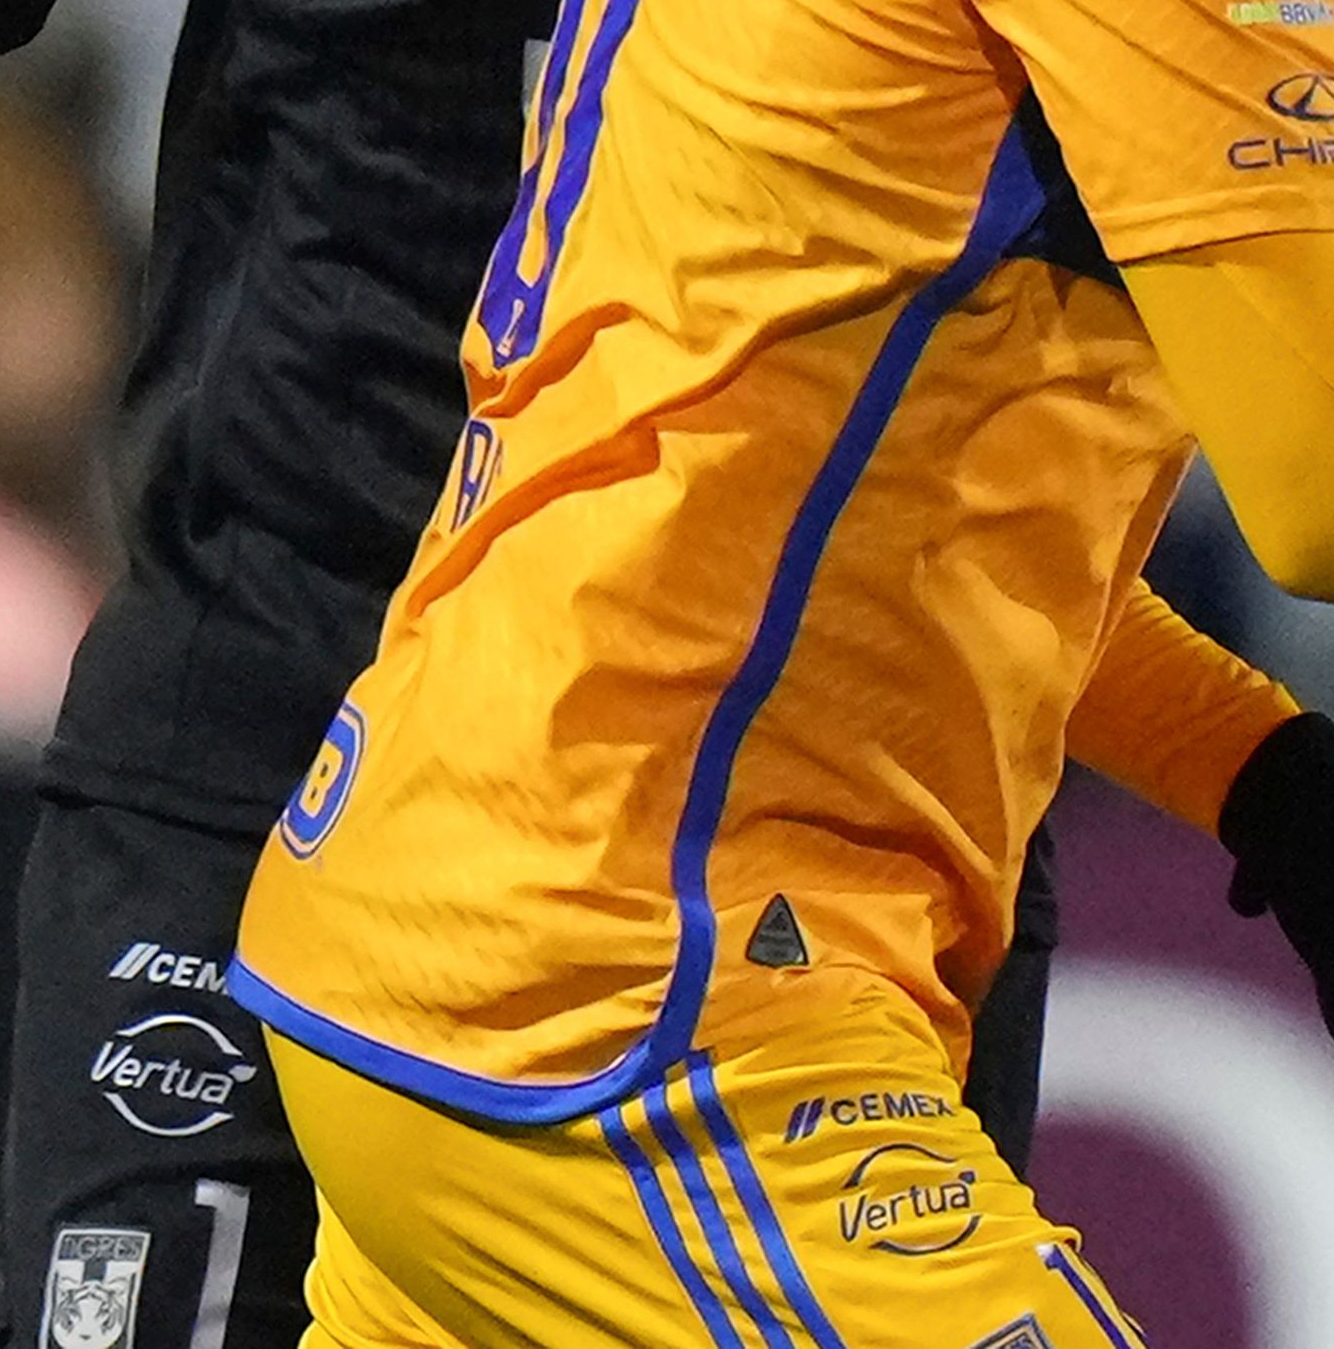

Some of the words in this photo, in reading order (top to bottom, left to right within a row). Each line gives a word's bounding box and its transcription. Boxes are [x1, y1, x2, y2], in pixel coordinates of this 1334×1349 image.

[90, 1041, 234, 1105] Vertua
[830, 1091, 956, 1126] CEMEX
[839, 1183, 972, 1243] Vertua
[189, 1177, 251, 1349] 1
